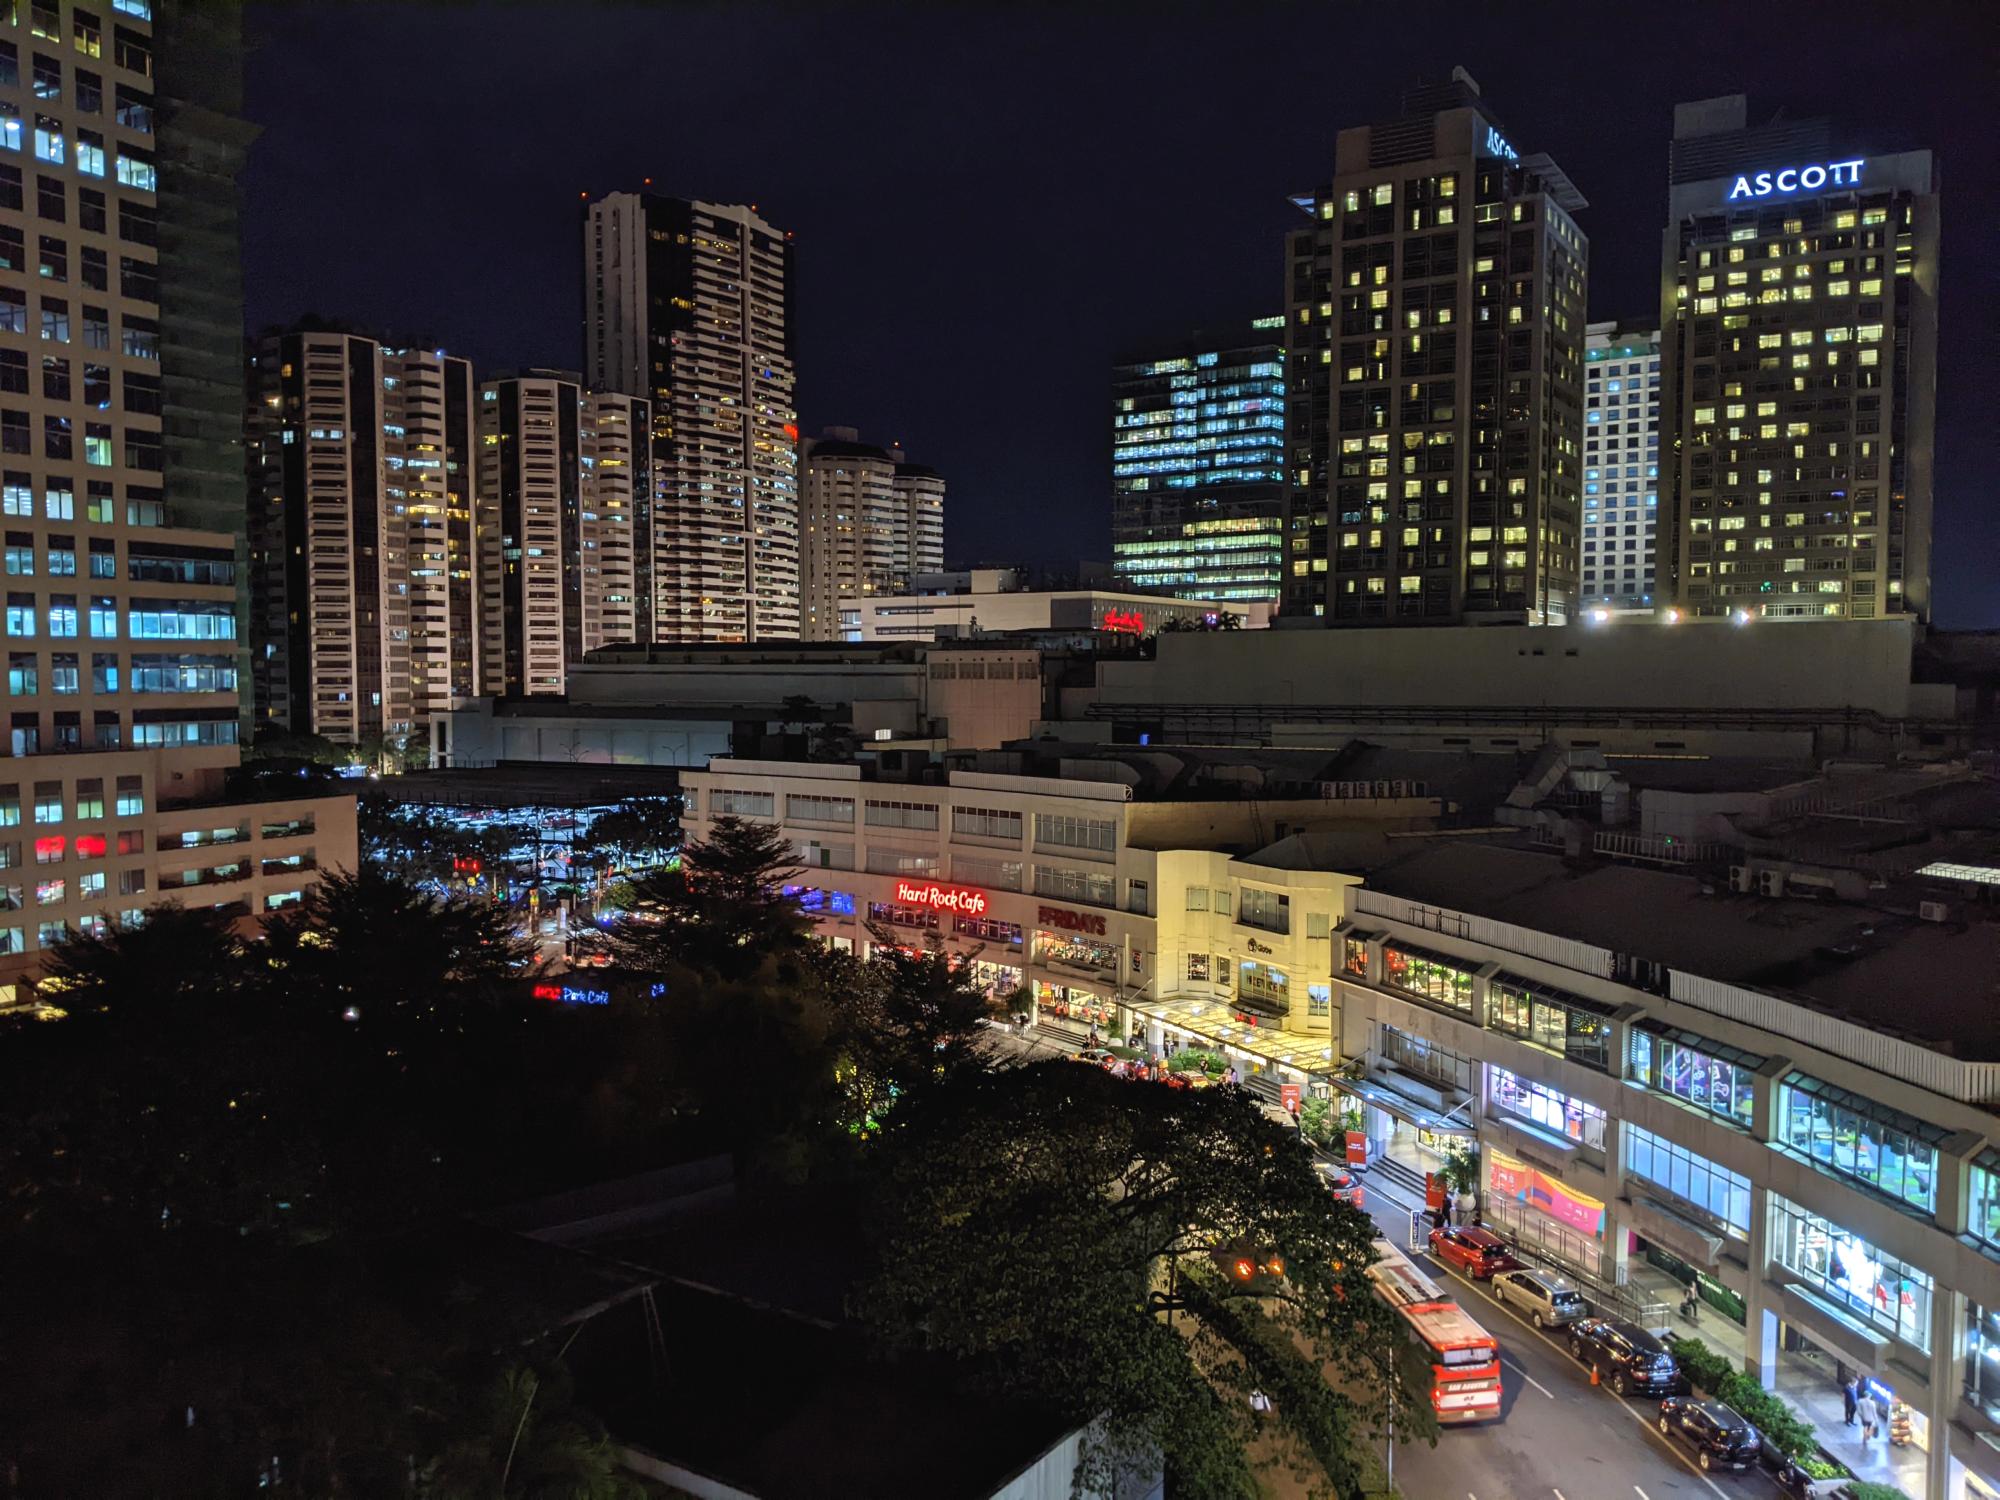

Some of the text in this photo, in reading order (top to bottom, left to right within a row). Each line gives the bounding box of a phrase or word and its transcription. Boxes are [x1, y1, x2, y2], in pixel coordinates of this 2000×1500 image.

[1729, 160, 1864, 199] ASCOTT
[898, 883, 985, 914] Hard Rock Cafe
